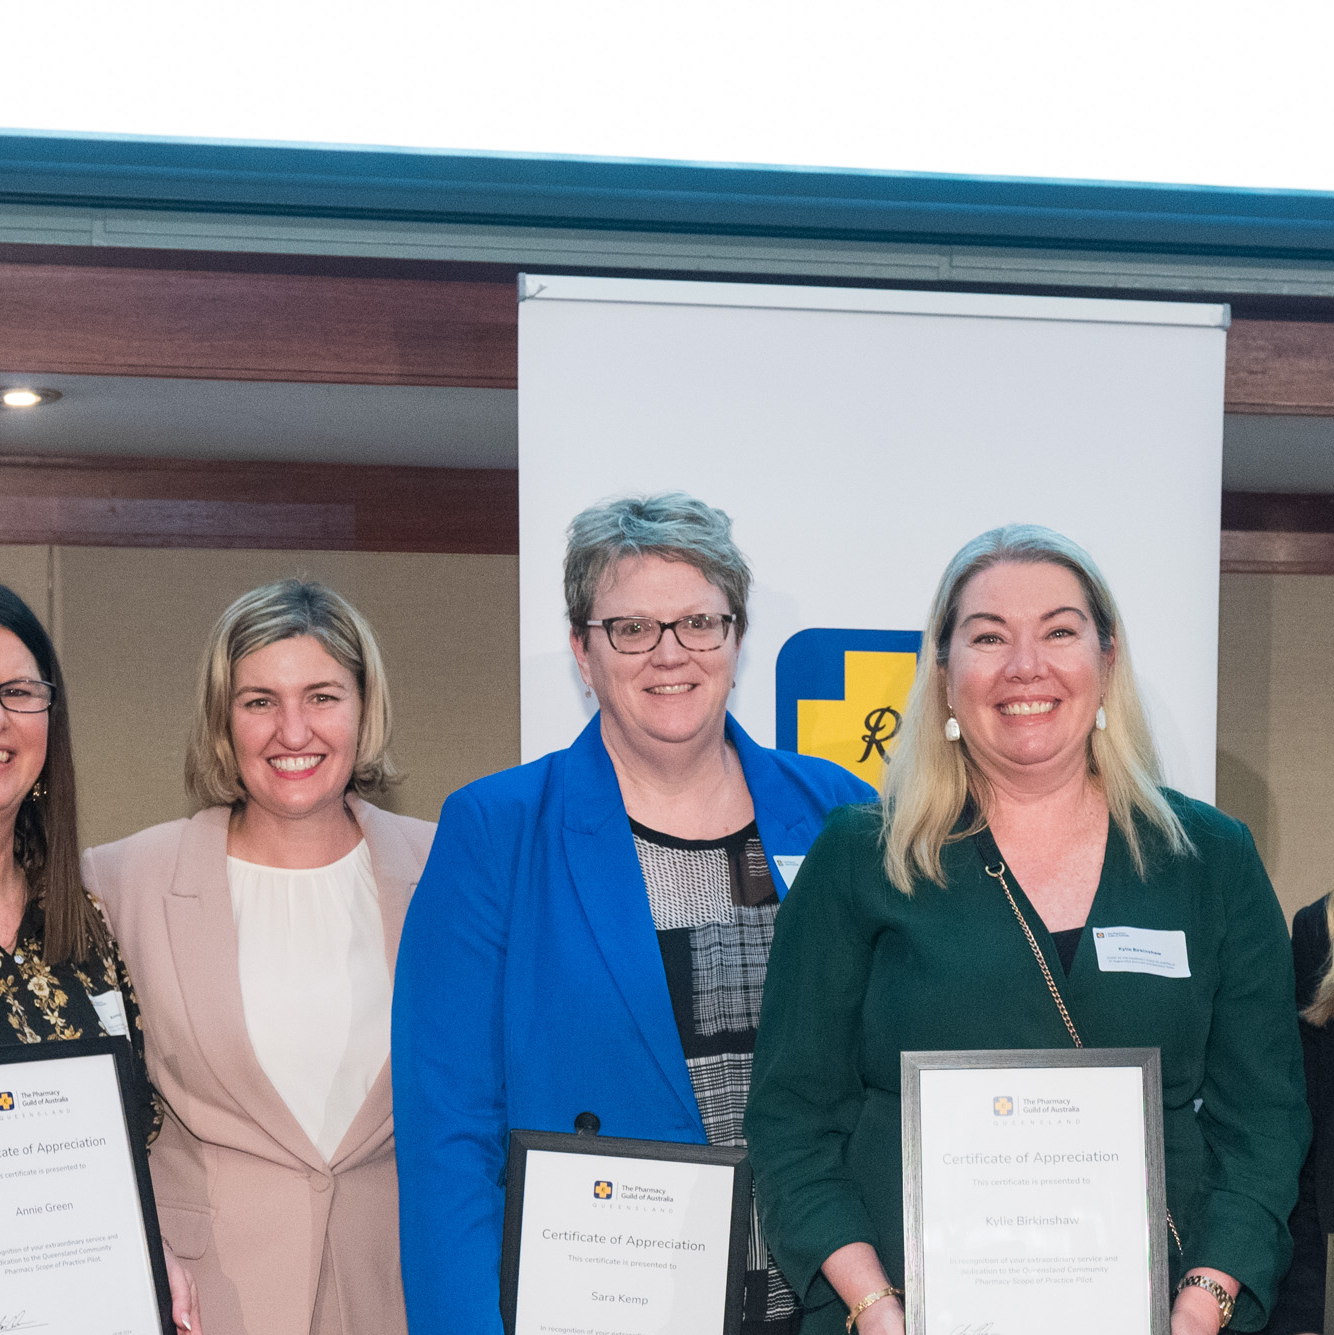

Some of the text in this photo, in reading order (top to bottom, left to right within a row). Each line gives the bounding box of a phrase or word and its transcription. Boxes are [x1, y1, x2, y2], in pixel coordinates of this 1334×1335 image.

[32, 1090, 60, 1098] Pharmacy
[22, 1099, 37, 1107] Guild
[44, 1096, 69, 1104] Australia
[1036, 1098, 1071, 1106] Pharmacy
[0, 1108, 71, 1121] QUEENSLAND
[22, 1143, 33, 1155] of
[37, 1137, 106, 1155] Appreciation
[942, 1150, 1119, 1165] Certificate of Appreciation
[4, 1169, 37, 1179] certificate
[45, 1163, 78, 1174] presented
[990, 1178, 1030, 1186] certificate
[1040, 1177, 1080, 1187] presented
[622, 1184, 666, 1195] The Pharmacy
[621, 1192, 638, 1200] Guild
[646, 1194, 674, 1203] Australia
[15, 1202, 74, 1216] Annie Green
[592, 1202, 674, 1214] QUEENSLAND
[986, 1215, 1079, 1228] Kylie Birkinshaw
[542, 1228, 706, 1251] Certificate of Appreciation
[568, 1254, 583, 1262] This
[584, 1257, 621, 1265] certificate
[630, 1261, 668, 1269] presented
[591, 1291, 649, 1306] Sara Kemp
